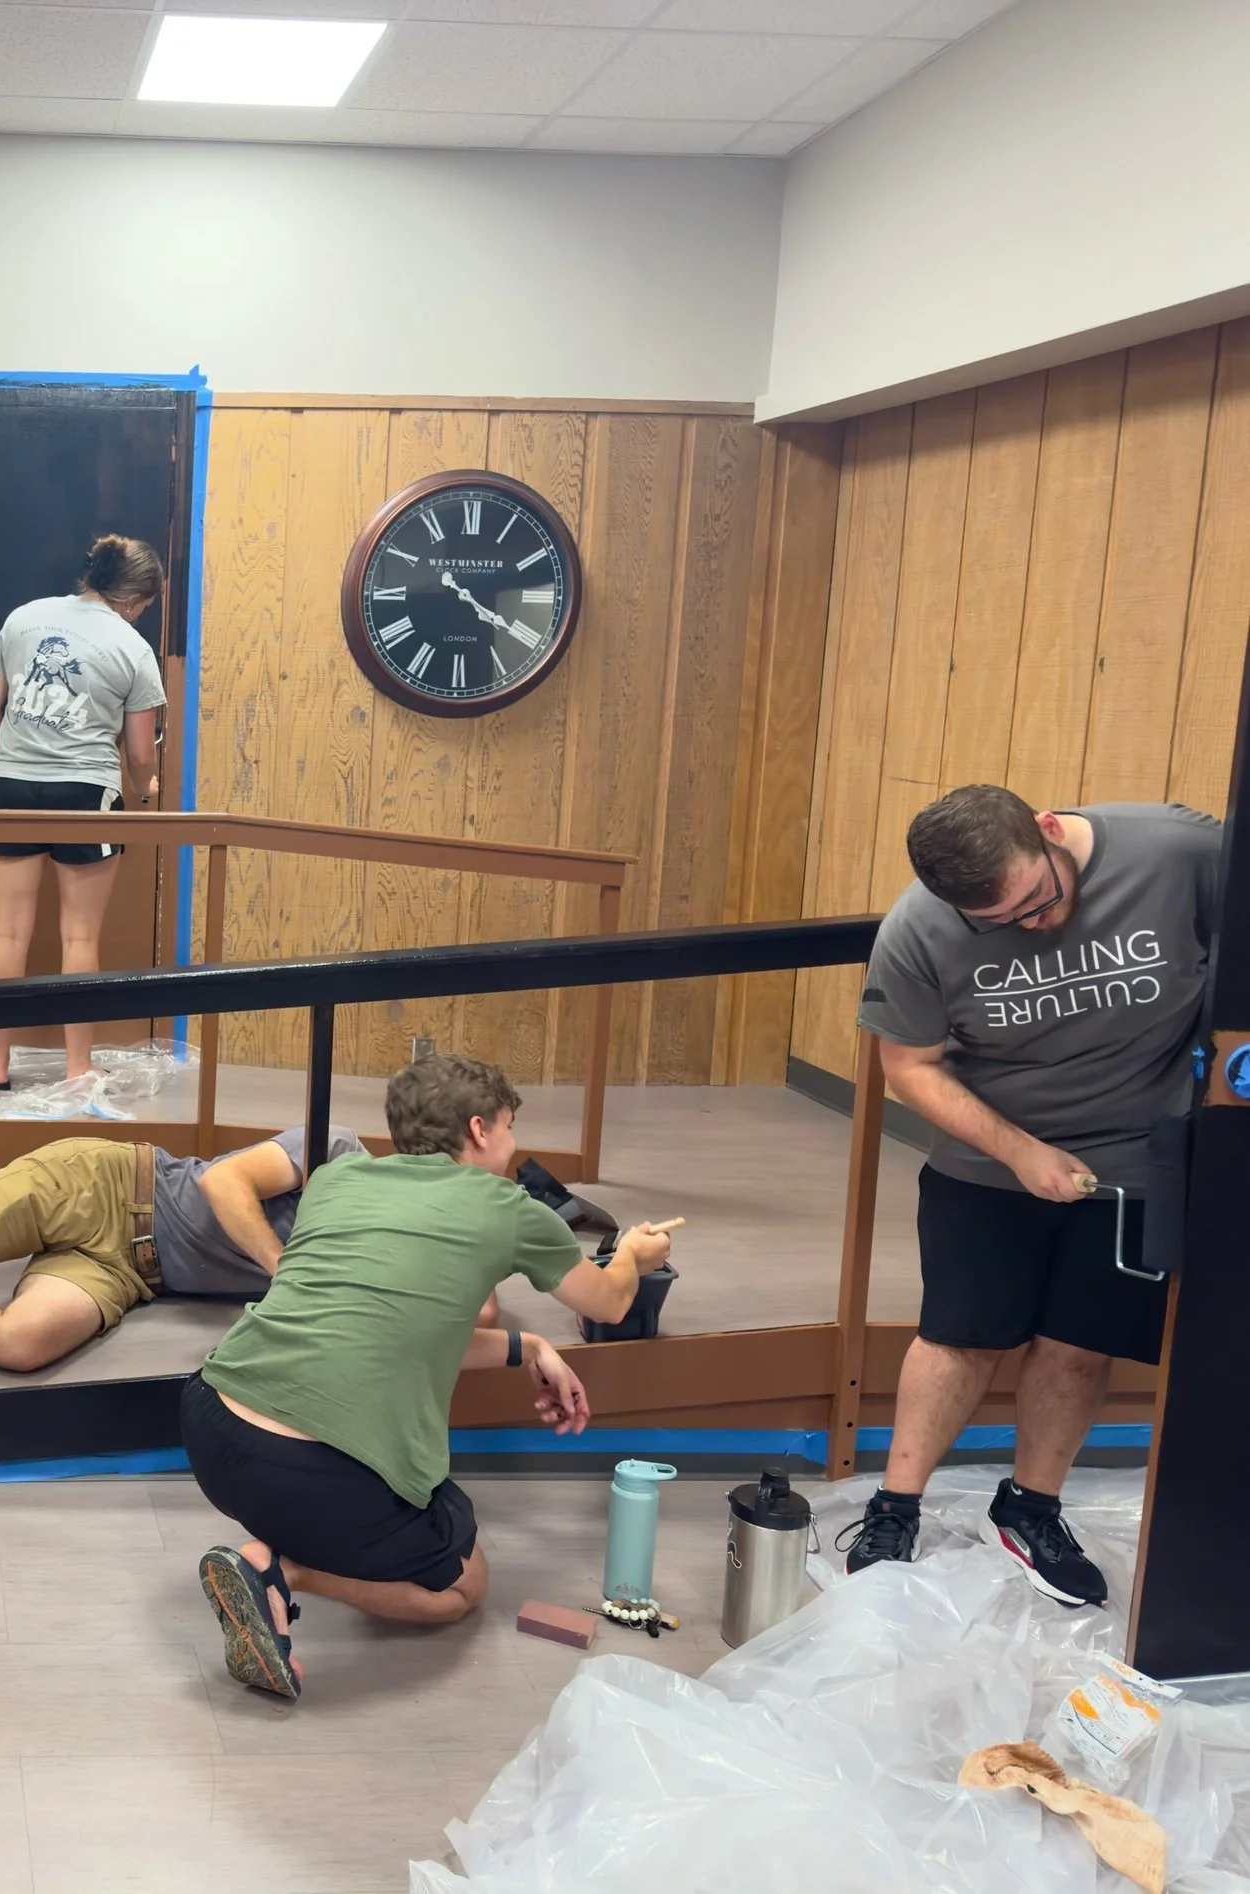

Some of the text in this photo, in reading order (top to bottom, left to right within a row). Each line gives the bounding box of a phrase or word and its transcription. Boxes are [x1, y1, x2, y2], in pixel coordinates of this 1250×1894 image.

[419, 508, 446, 545] XI
[460, 500, 482, 535] XII
[496, 513, 518, 544] I
[386, 542, 419, 568] X
[429, 558, 504, 568] WESTMINSTER
[515, 547, 548, 572] II
[372, 586, 406, 601] IX
[522, 590, 554, 604] III
[378, 616, 416, 650] VIII
[406, 642, 436, 679] VII
[452, 654, 466, 688] VI
[490, 645, 507, 678] V
[12, 672, 90, 729] 2024
[973, 930, 1161, 990] CALLING
[984, 975, 1161, 1027] CULTURE
